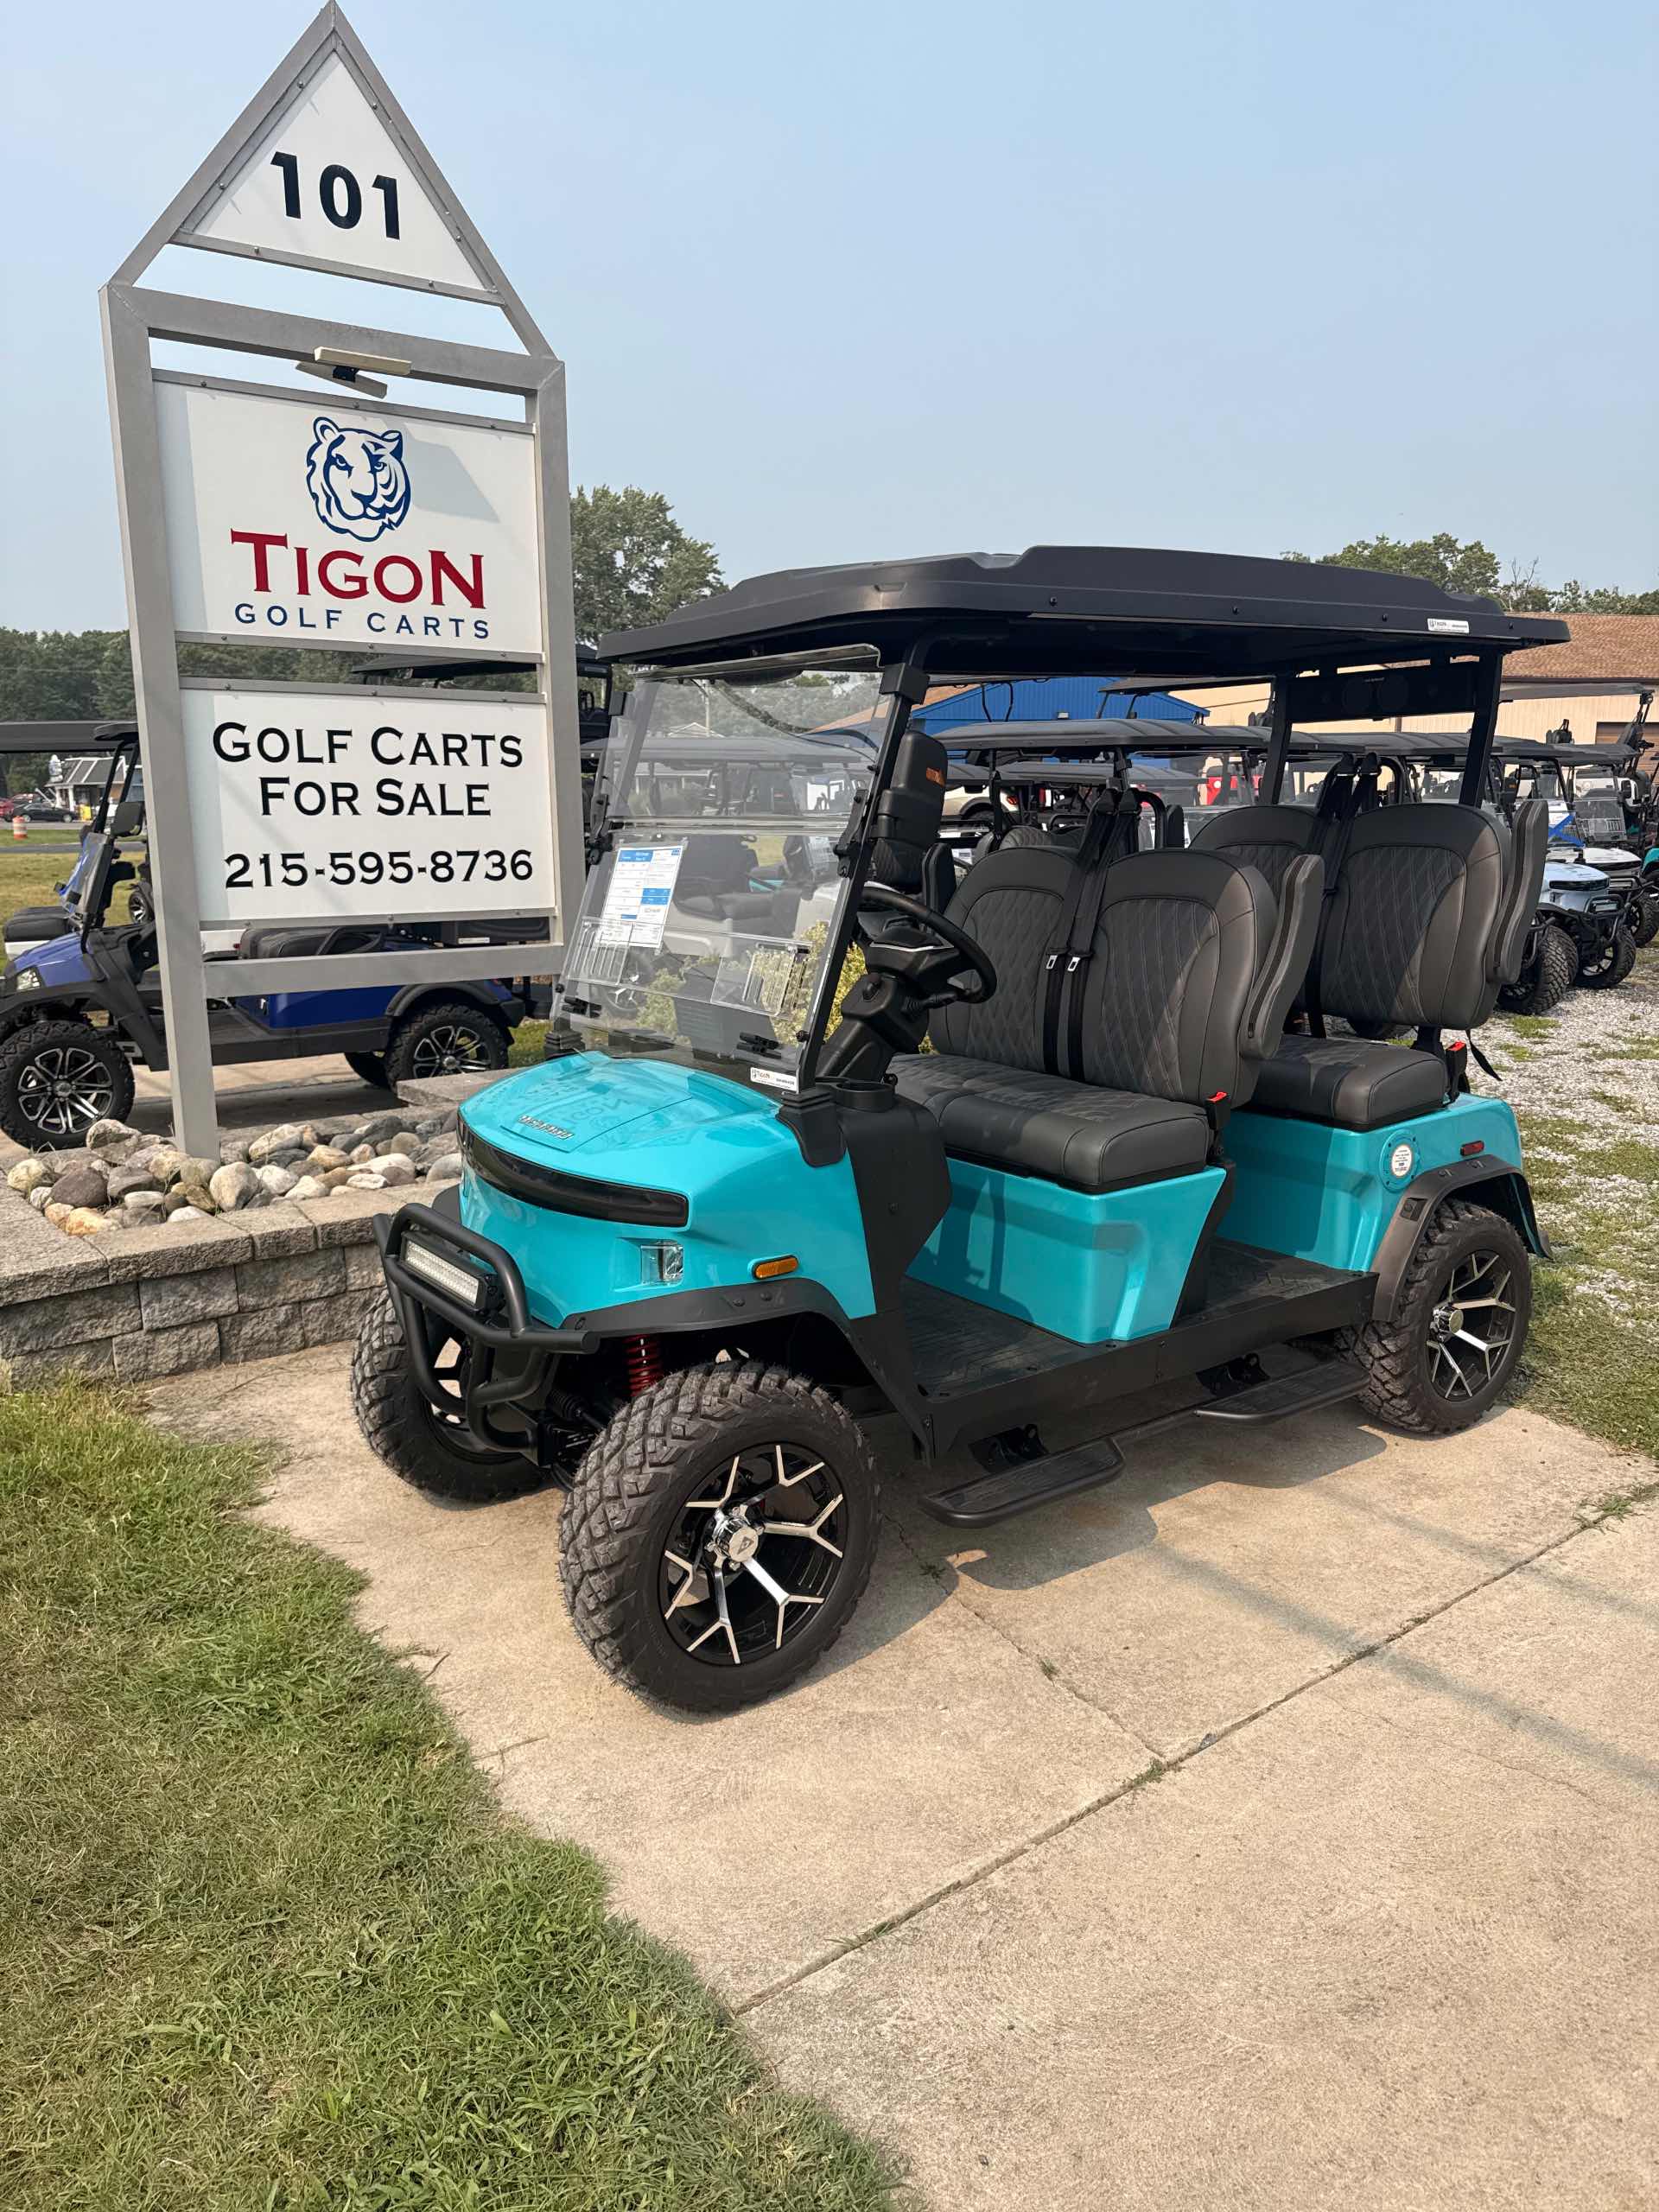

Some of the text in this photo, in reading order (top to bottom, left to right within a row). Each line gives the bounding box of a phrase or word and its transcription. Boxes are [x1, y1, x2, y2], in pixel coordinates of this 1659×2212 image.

[270, 151, 401, 240] 101
[231, 528, 486, 610] TIGON
[235, 602, 490, 639] GOLF CARTS
[213, 721, 523, 768] GOLF CARTS
[259, 776, 492, 817] FOR SALE
[224, 849, 533, 889] 215-595-8736
